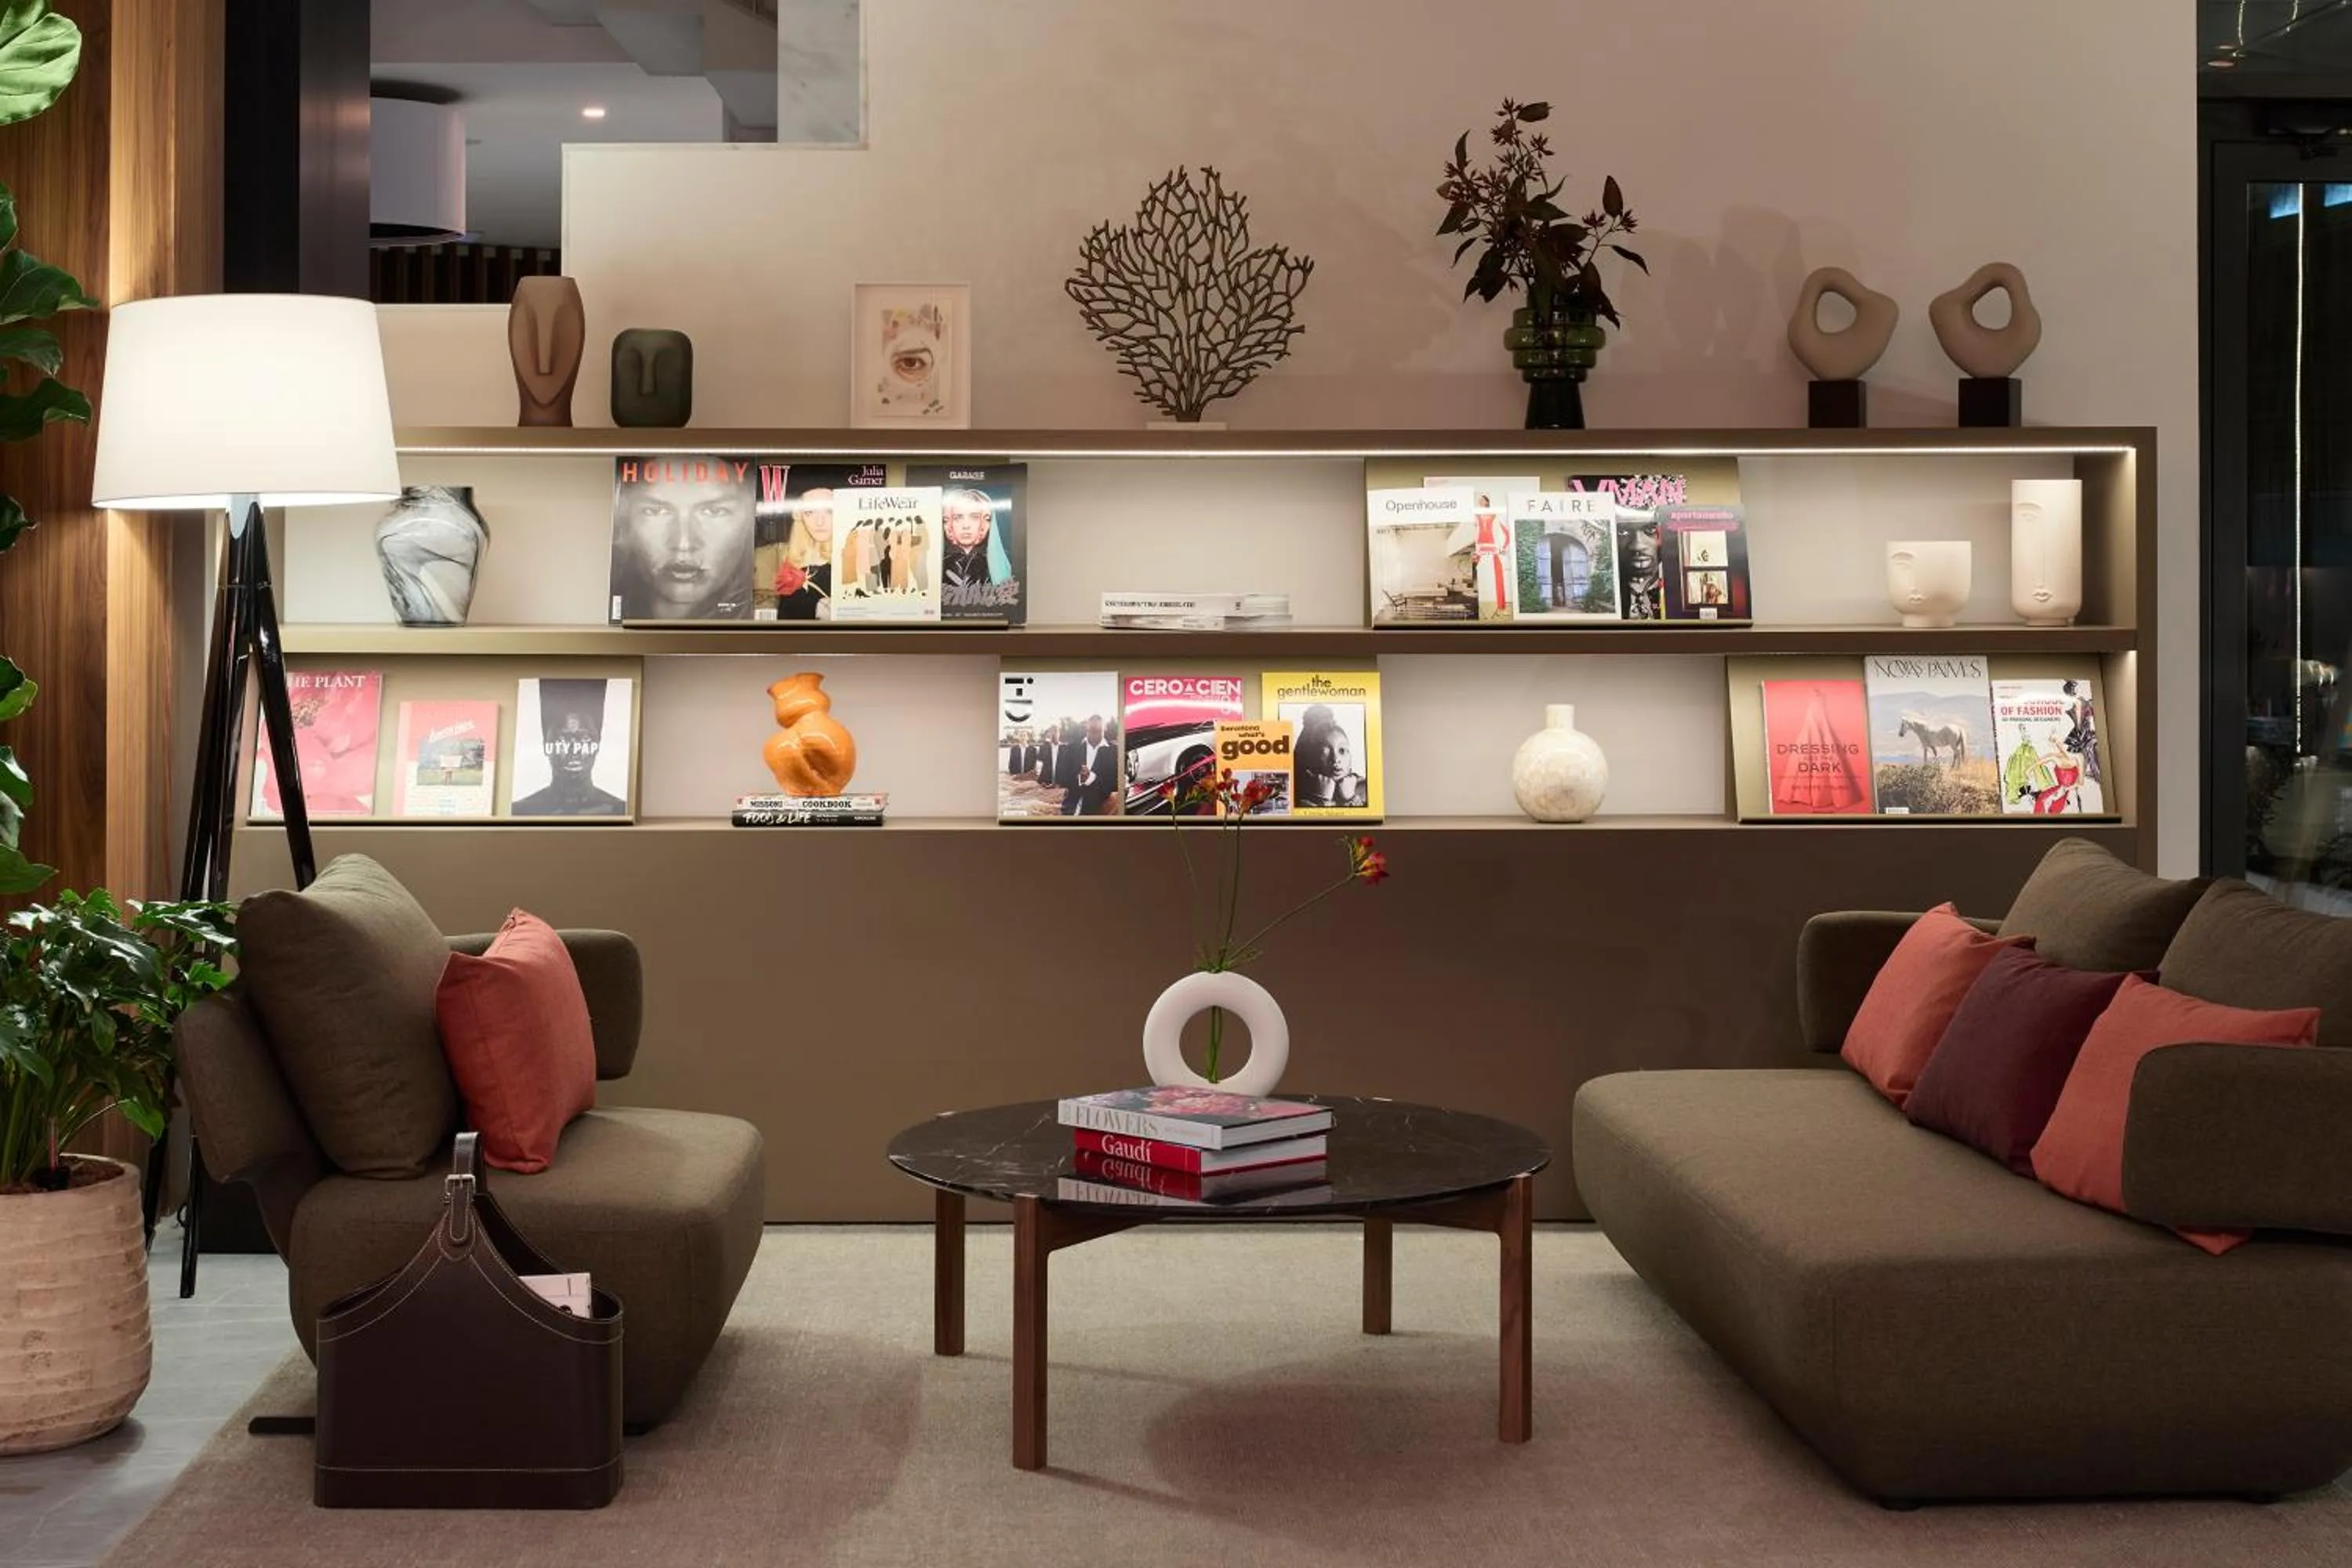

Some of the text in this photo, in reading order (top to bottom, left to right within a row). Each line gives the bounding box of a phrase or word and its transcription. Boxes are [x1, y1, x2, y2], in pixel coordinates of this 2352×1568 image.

[622, 462, 749, 483] HOLIDAY
[862, 466, 884, 477] Julia
[759, 464, 790, 504] W
[858, 496, 918, 510] LifeWear
[1385, 499, 1457, 514] Openhouse
[1528, 499, 1596, 512] FAIRE
[287, 675, 365, 688] HE PLANT
[1130, 678, 1184, 696] CERO
[1196, 679, 1241, 695] CIEN
[1312, 674, 1332, 688] the
[1277, 683, 1367, 699] gentlewoman
[2001, 706, 2063, 715] OF FASHION
[1221, 735, 1290, 760] good
[1777, 744, 1860, 754] DRESSING
[1798, 762, 1842, 772] DARK
[788, 810, 812, 824] LIFE
[1102, 1134, 1152, 1163] Gaudí
